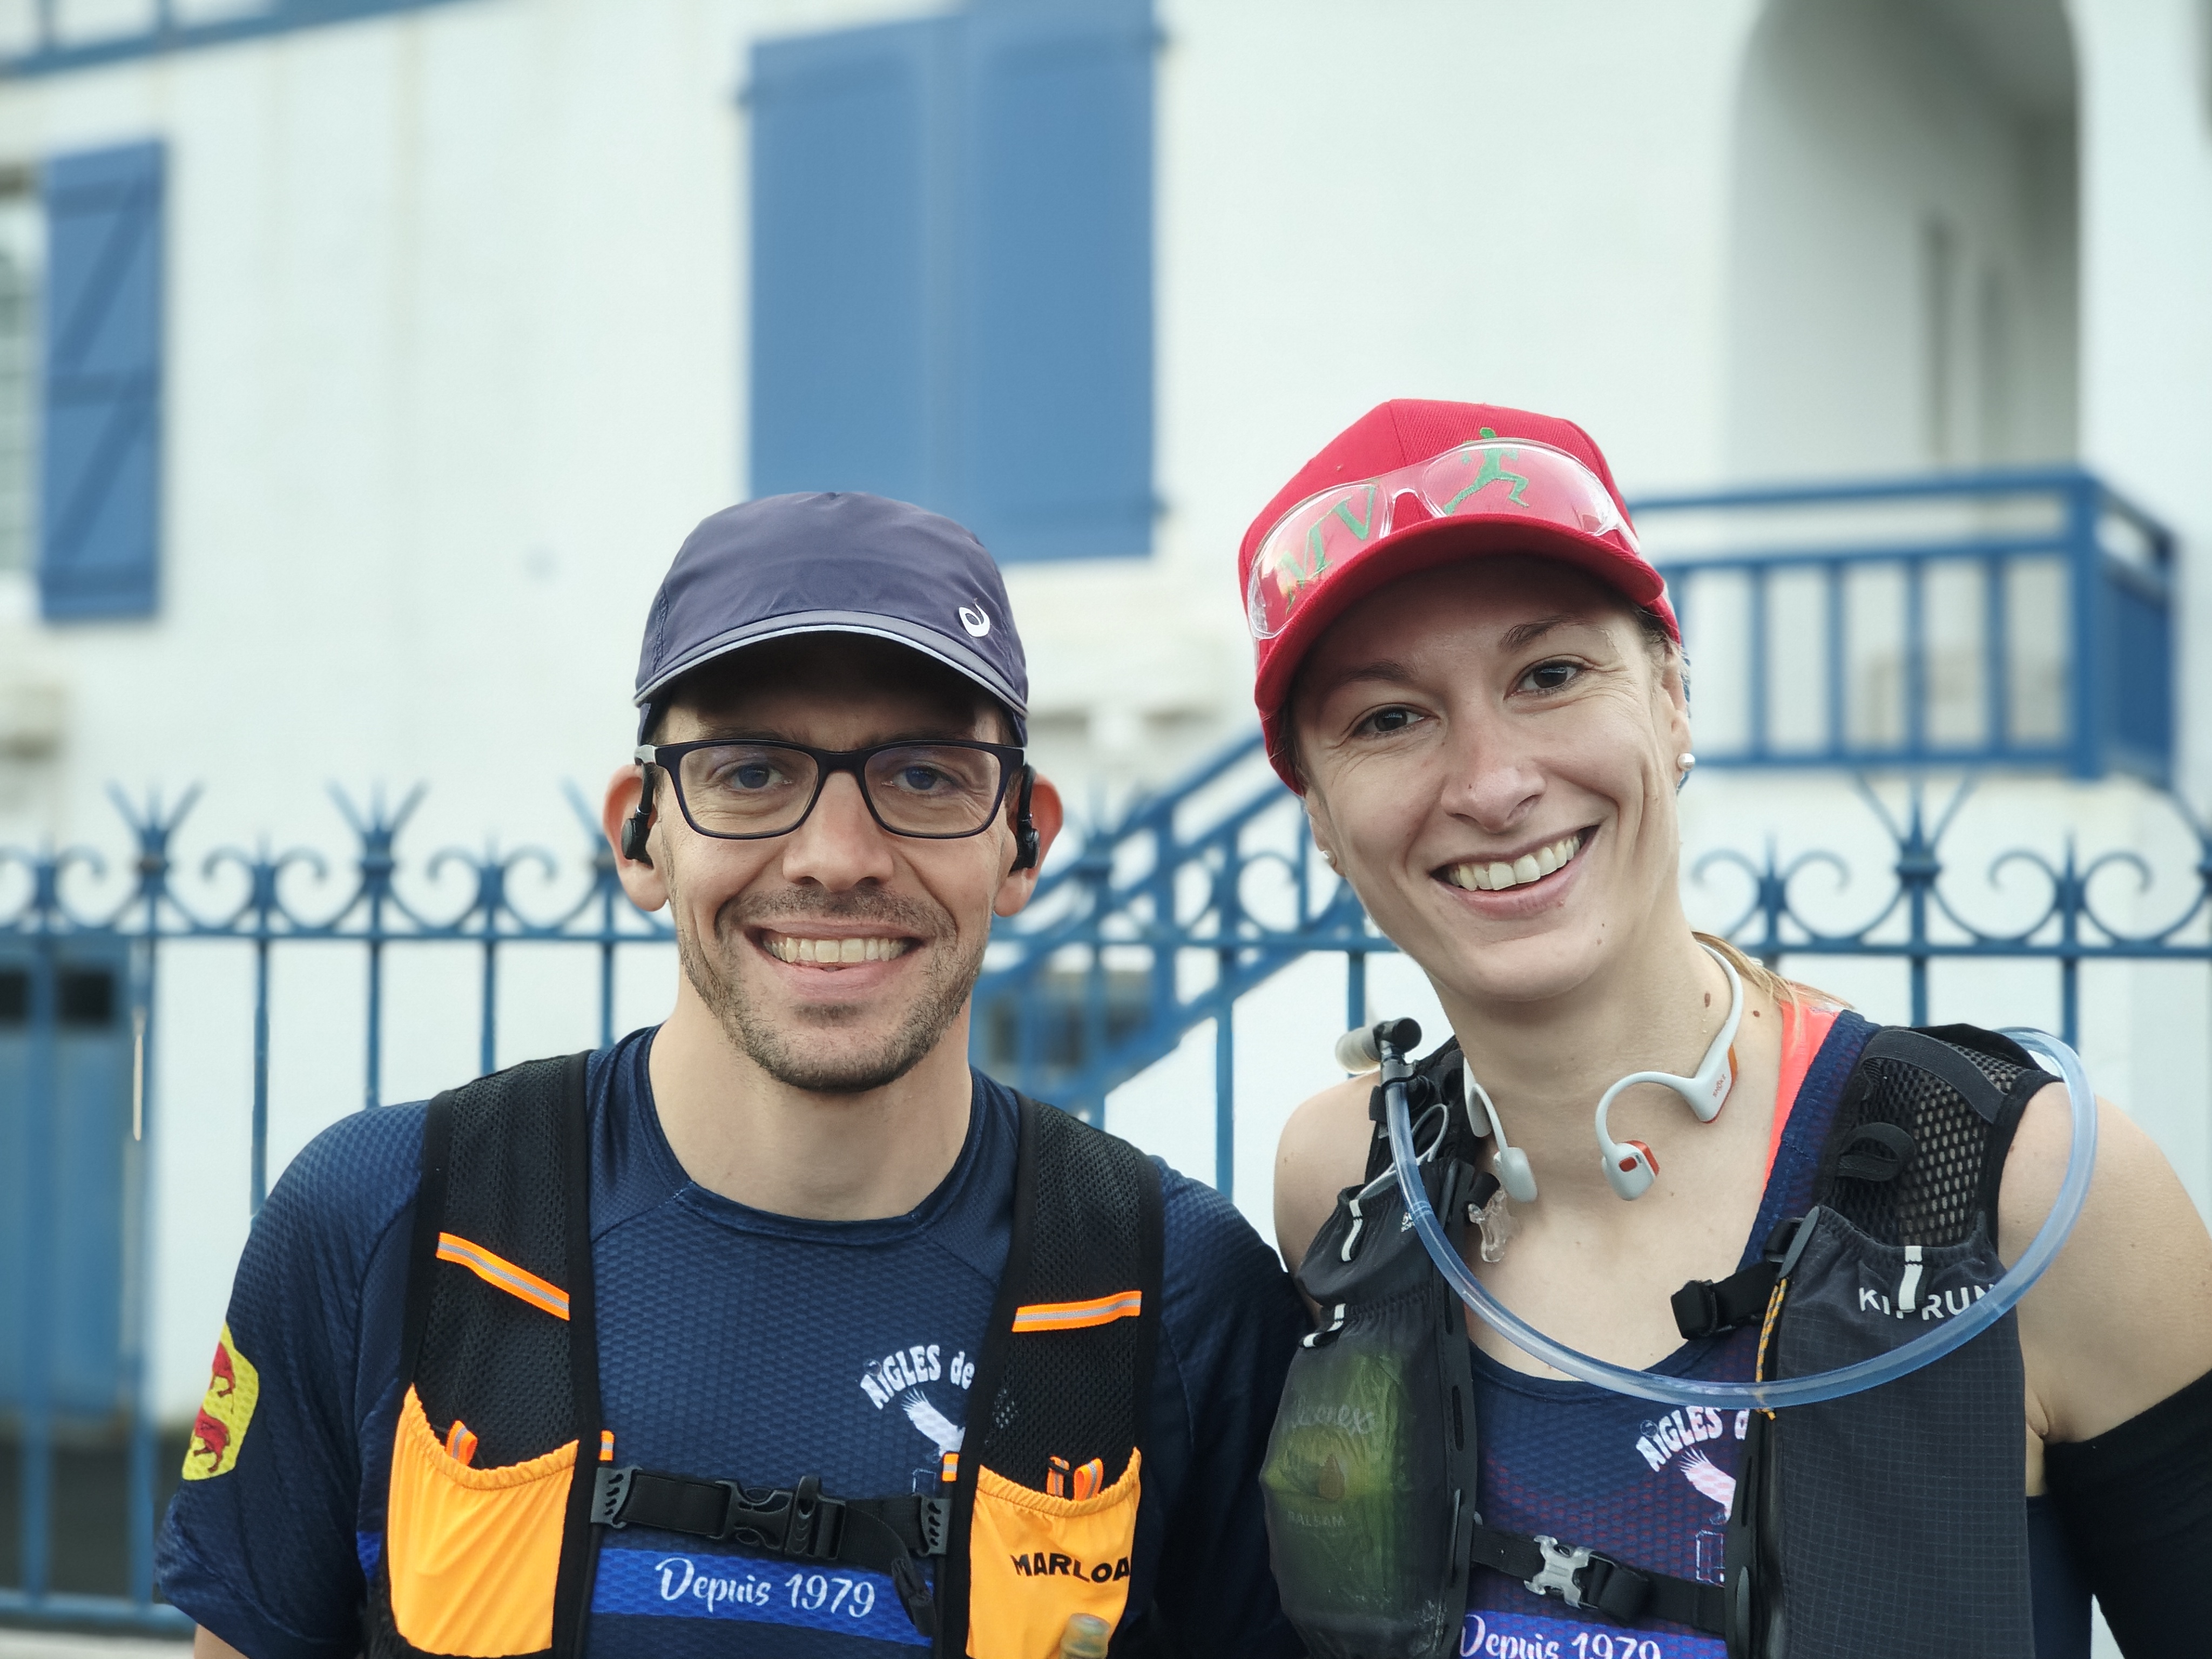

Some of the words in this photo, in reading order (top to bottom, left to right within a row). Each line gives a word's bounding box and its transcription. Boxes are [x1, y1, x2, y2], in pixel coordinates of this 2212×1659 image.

[1859, 1284, 1995, 1320] KIRU
[950, 1351, 975, 1390] de
[655, 1557, 772, 1614] Depuis
[785, 1574, 875, 1618] 1979
[1459, 1614, 1560, 1659] Depuis
